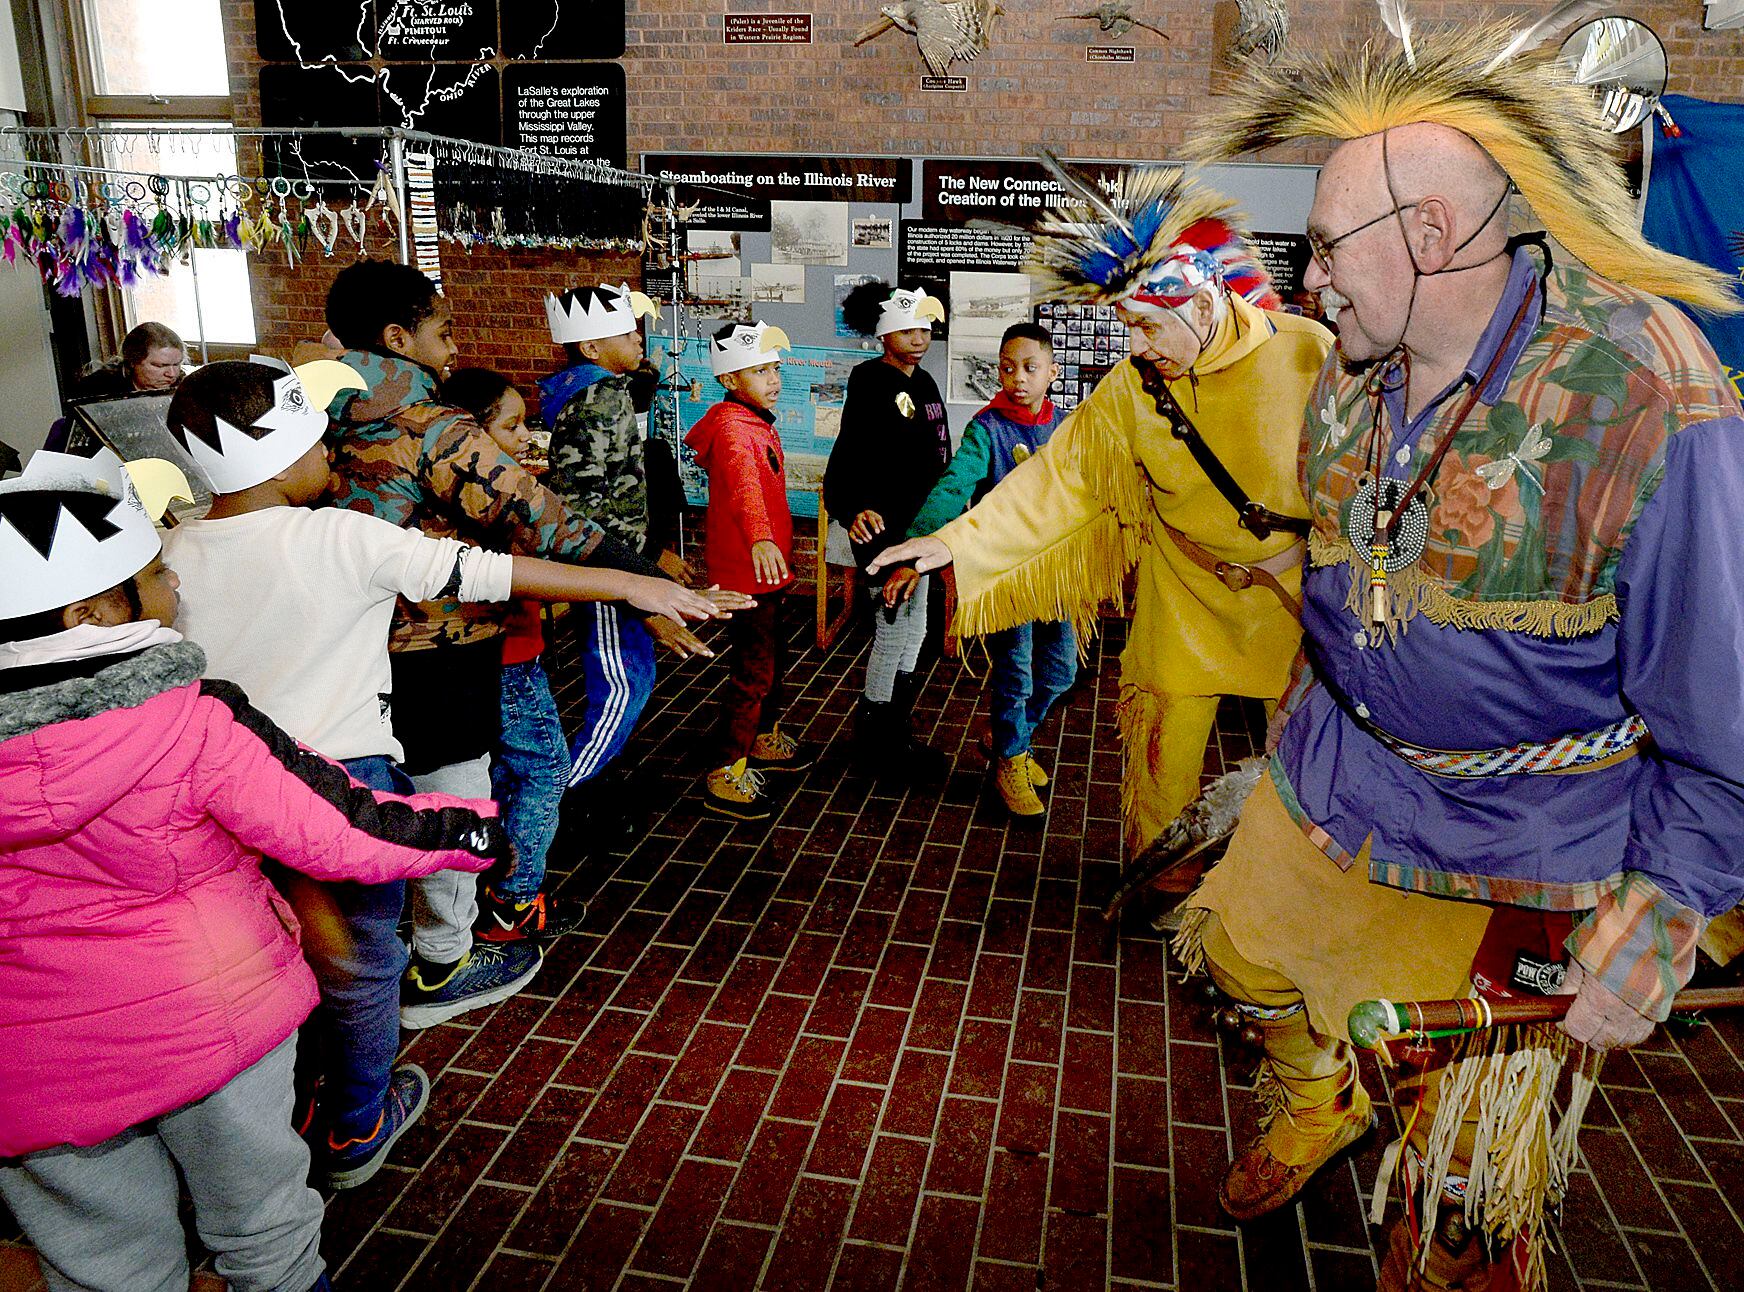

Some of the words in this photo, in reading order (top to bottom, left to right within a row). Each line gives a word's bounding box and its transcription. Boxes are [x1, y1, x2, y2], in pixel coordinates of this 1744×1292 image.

[402, 5, 418, 18] Ft.
[422, 5, 436, 16] St.
[438, 3, 473, 16] Louis
[388, 36, 400, 44] Ft.
[468, 63, 492, 88] RIVER
[440, 88, 464, 102] OHIO
[518, 86, 558, 96] LaSalle's
[560, 86, 609, 97] exploration
[518, 98, 528, 108] of
[530, 98, 544, 108] the
[546, 98, 572, 108] Great
[574, 98, 600, 108] Lakes
[518, 110, 552, 120] through
[554, 110, 568, 118] the
[570, 111, 596, 120] upper
[518, 122, 564, 132] Mississippi
[566, 122, 594, 132] Valley.
[520, 134, 538, 142] This
[540, 135, 558, 144] map
[560, 134, 594, 142] records
[519, 145, 538, 155] Fort
[540, 145, 552, 154] St.
[554, 146, 578, 154] Louis
[580, 146, 590, 154] at
[596, 158, 610, 167] the
[660, 170, 754, 188] Steamboating
[756, 175, 774, 185] on
[778, 172, 800, 186] the
[804, 172, 852, 187] Illinois
[856, 174, 897, 188] River
[938, 176, 966, 190] The
[969, 177, 1000, 190] New
[938, 192, 997, 206] Creation
[1000, 193, 1014, 206] of
[1018, 194, 1042, 207] the
[787, 357, 806, 366] River
[1518, 962, 1538, 980] POW
